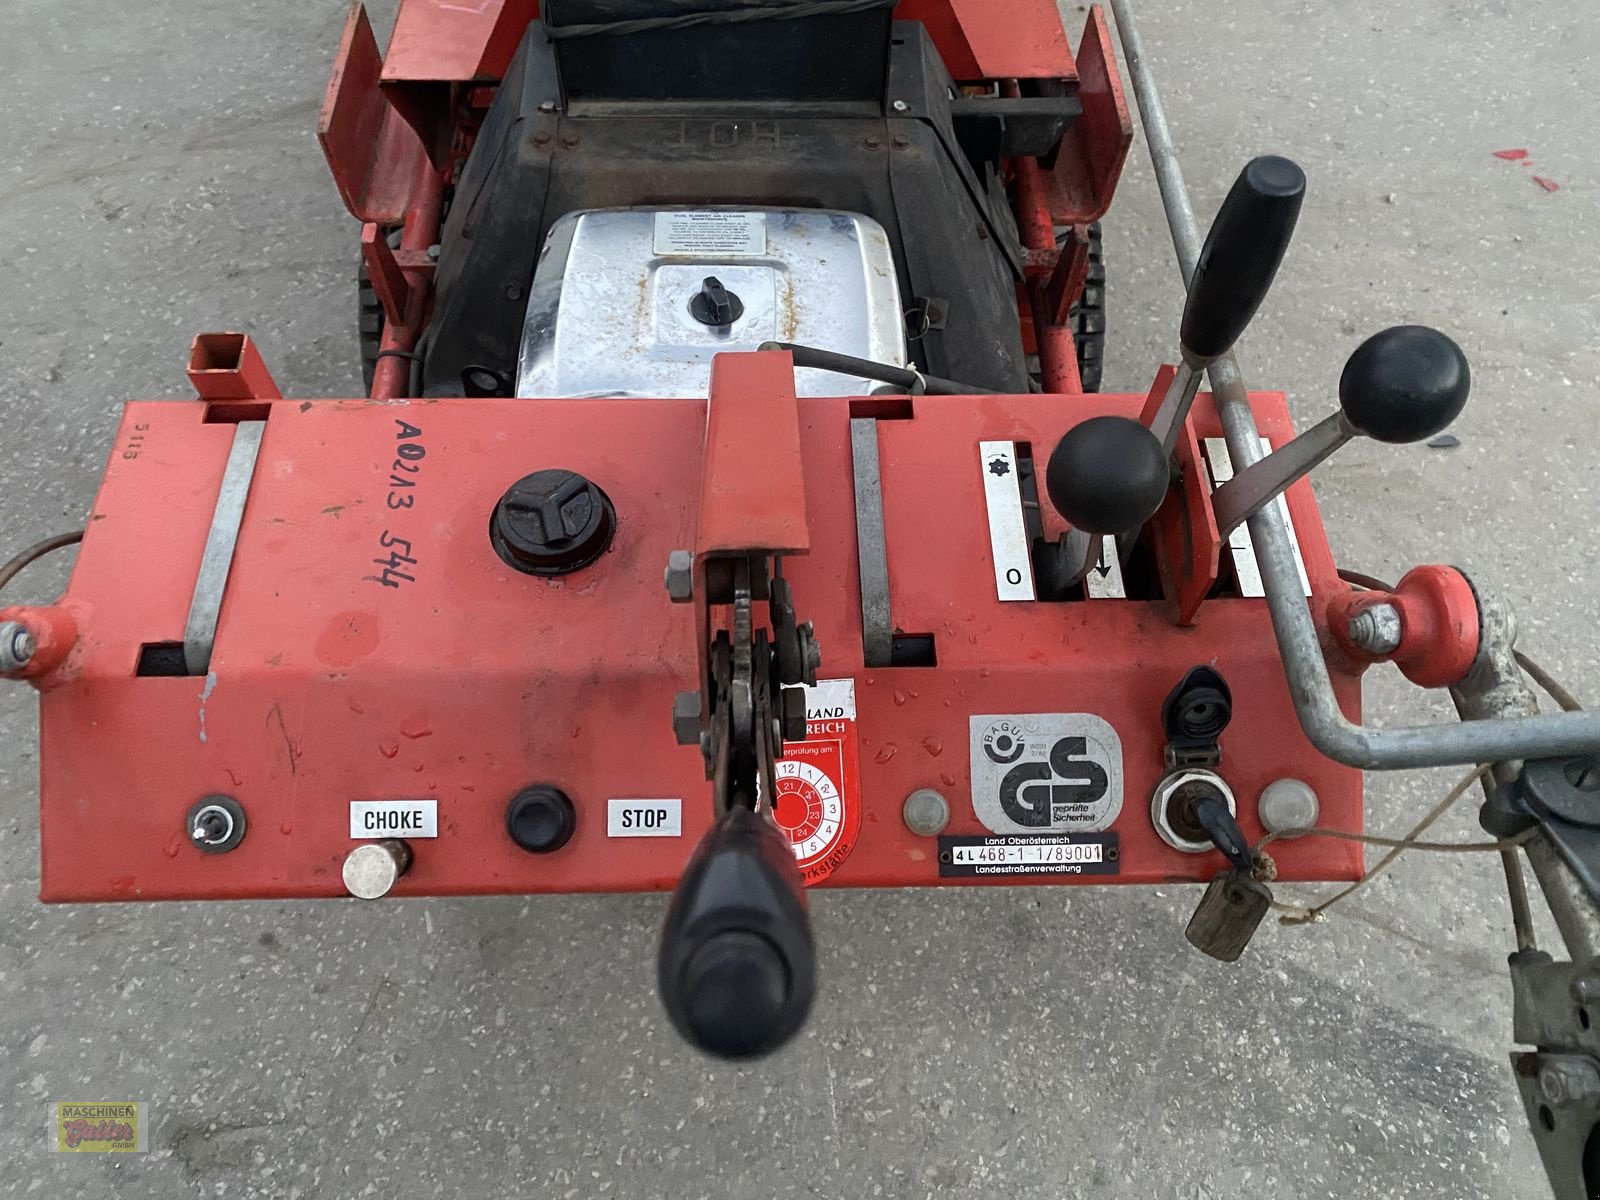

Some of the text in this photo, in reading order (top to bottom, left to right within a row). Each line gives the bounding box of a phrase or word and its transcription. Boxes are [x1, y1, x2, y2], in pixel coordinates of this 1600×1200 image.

[806, 707, 844, 720] LAND
[806, 722, 845, 735] REICH
[984, 722, 1025, 743] BAGUV
[783, 747, 819, 756] erprüfung
[782, 764, 795, 774] 12
[829, 804, 836, 814] 3
[1053, 804, 1089, 816] geprüfte
[364, 810, 423, 830] CHOKE
[621, 809, 668, 828] STOP
[1053, 813, 1096, 823] Sicherheit
[825, 825, 832, 834] 4
[985, 836, 1070, 846] Land Oberösterreich
[810, 842, 817, 852] 5
[800, 843, 849, 880] erkstätte
[975, 864, 1082, 874] Landesstraßenverwaltung
